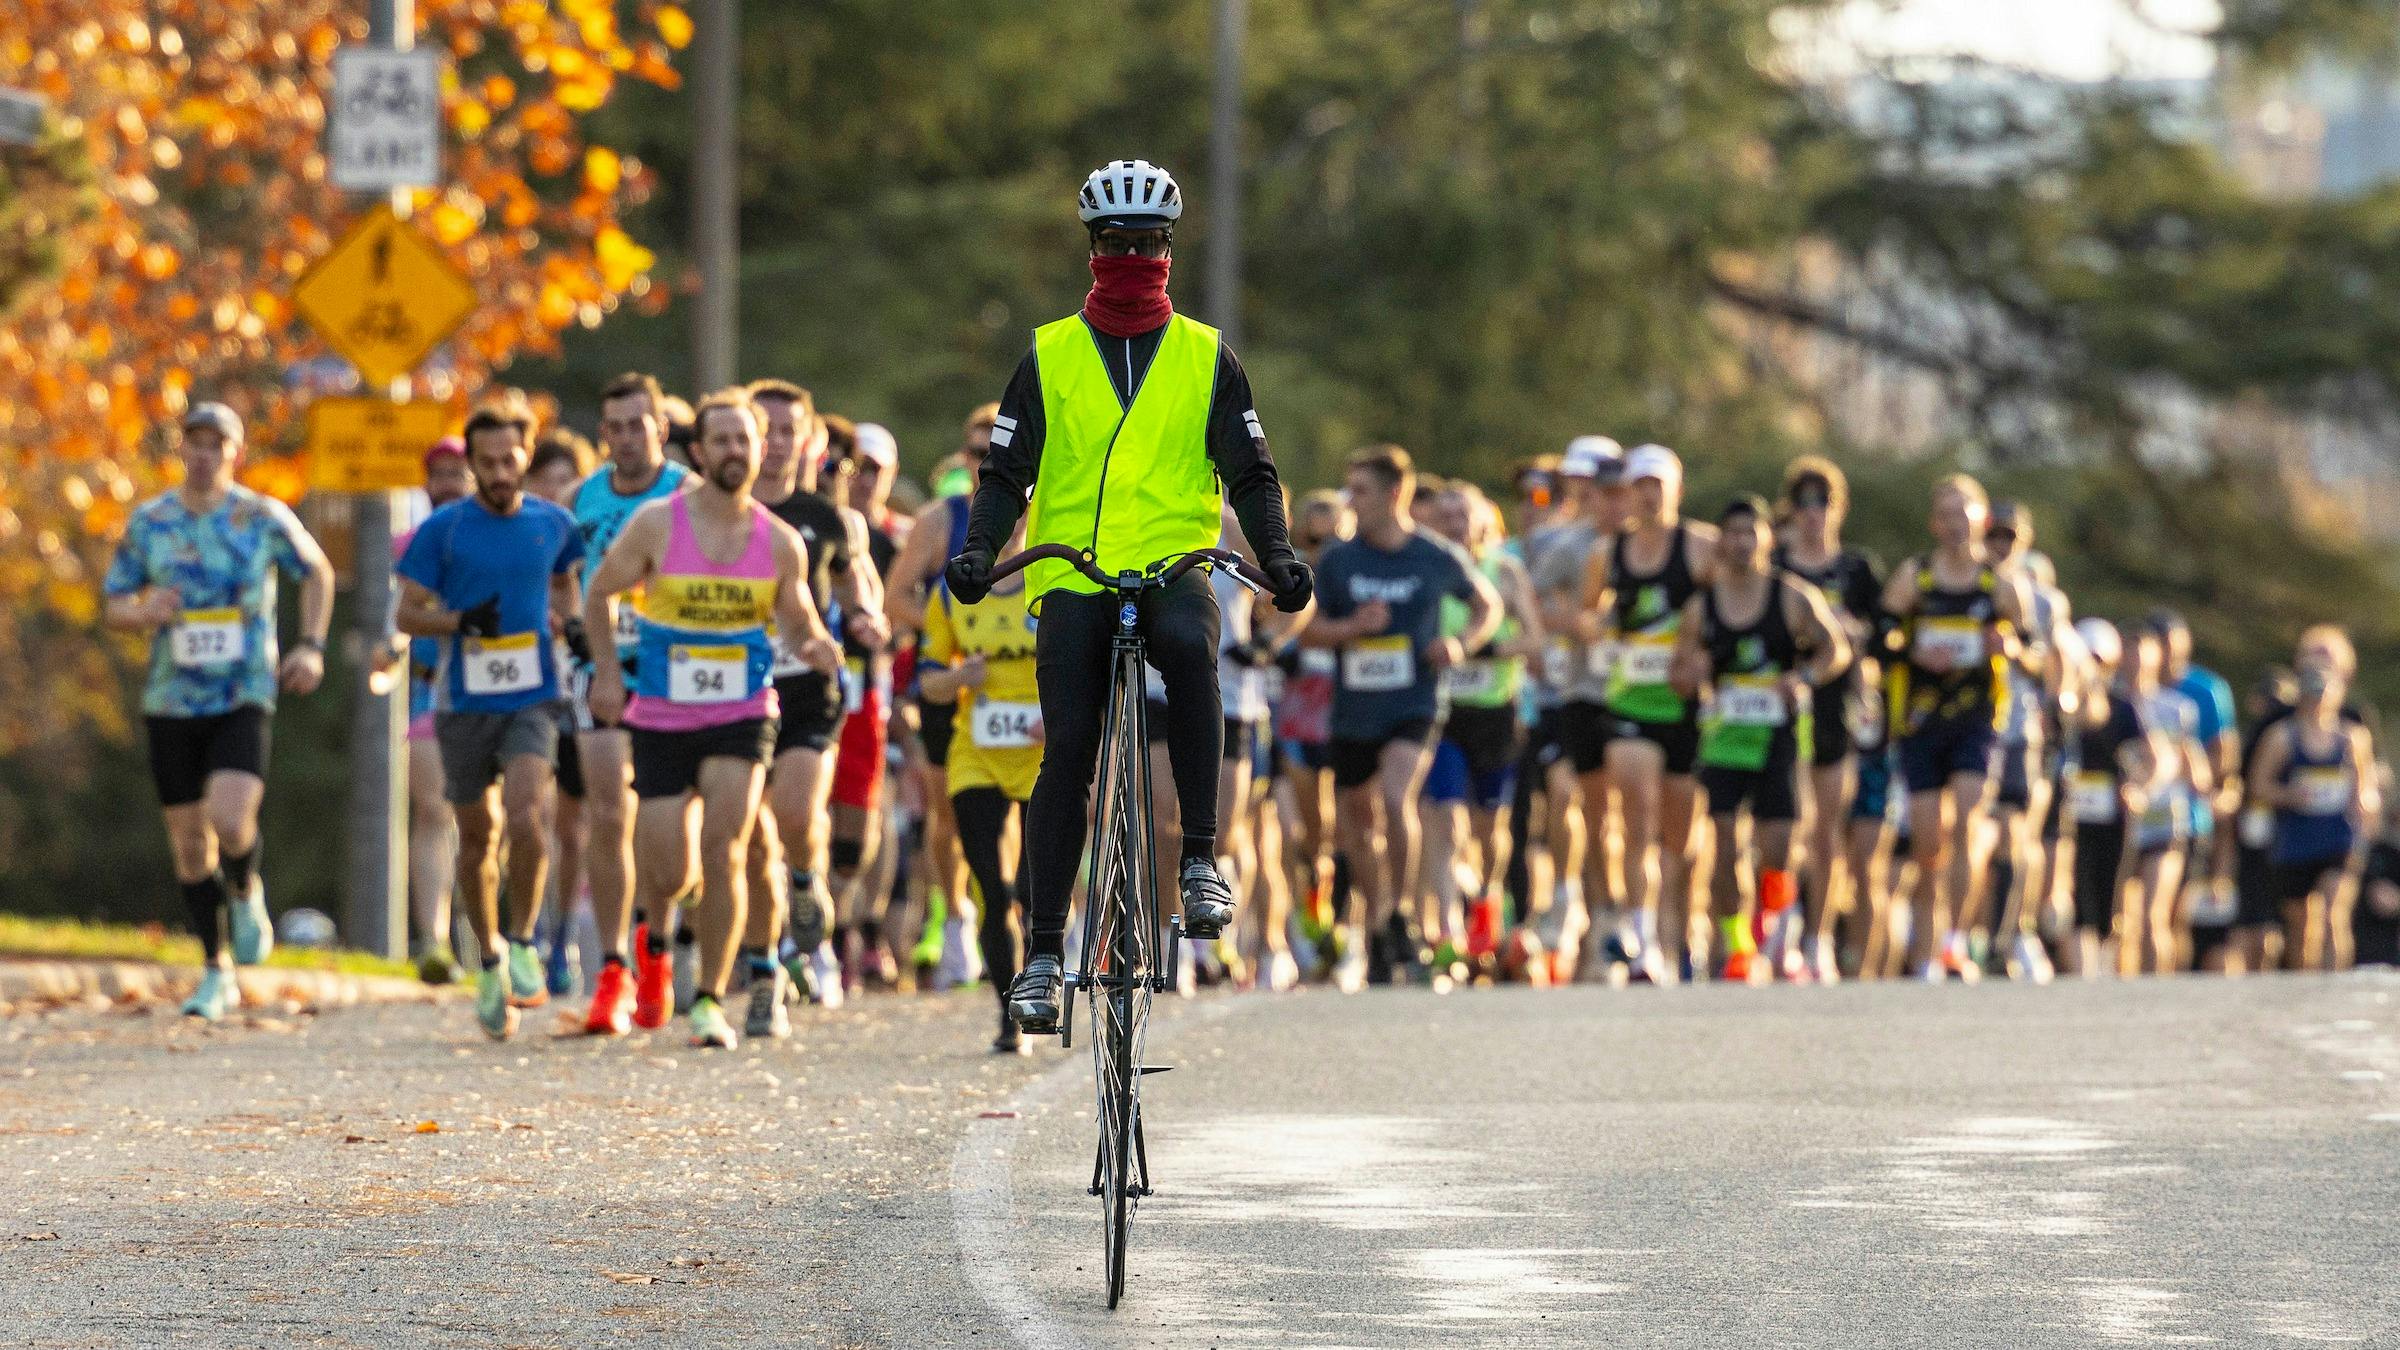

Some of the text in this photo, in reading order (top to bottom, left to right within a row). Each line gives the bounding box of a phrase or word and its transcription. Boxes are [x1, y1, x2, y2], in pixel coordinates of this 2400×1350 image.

[686, 583, 754, 603] ULTRA
[486, 658, 521, 684] 96
[692, 669, 725, 694] 94
[986, 711, 1029, 738] 614
